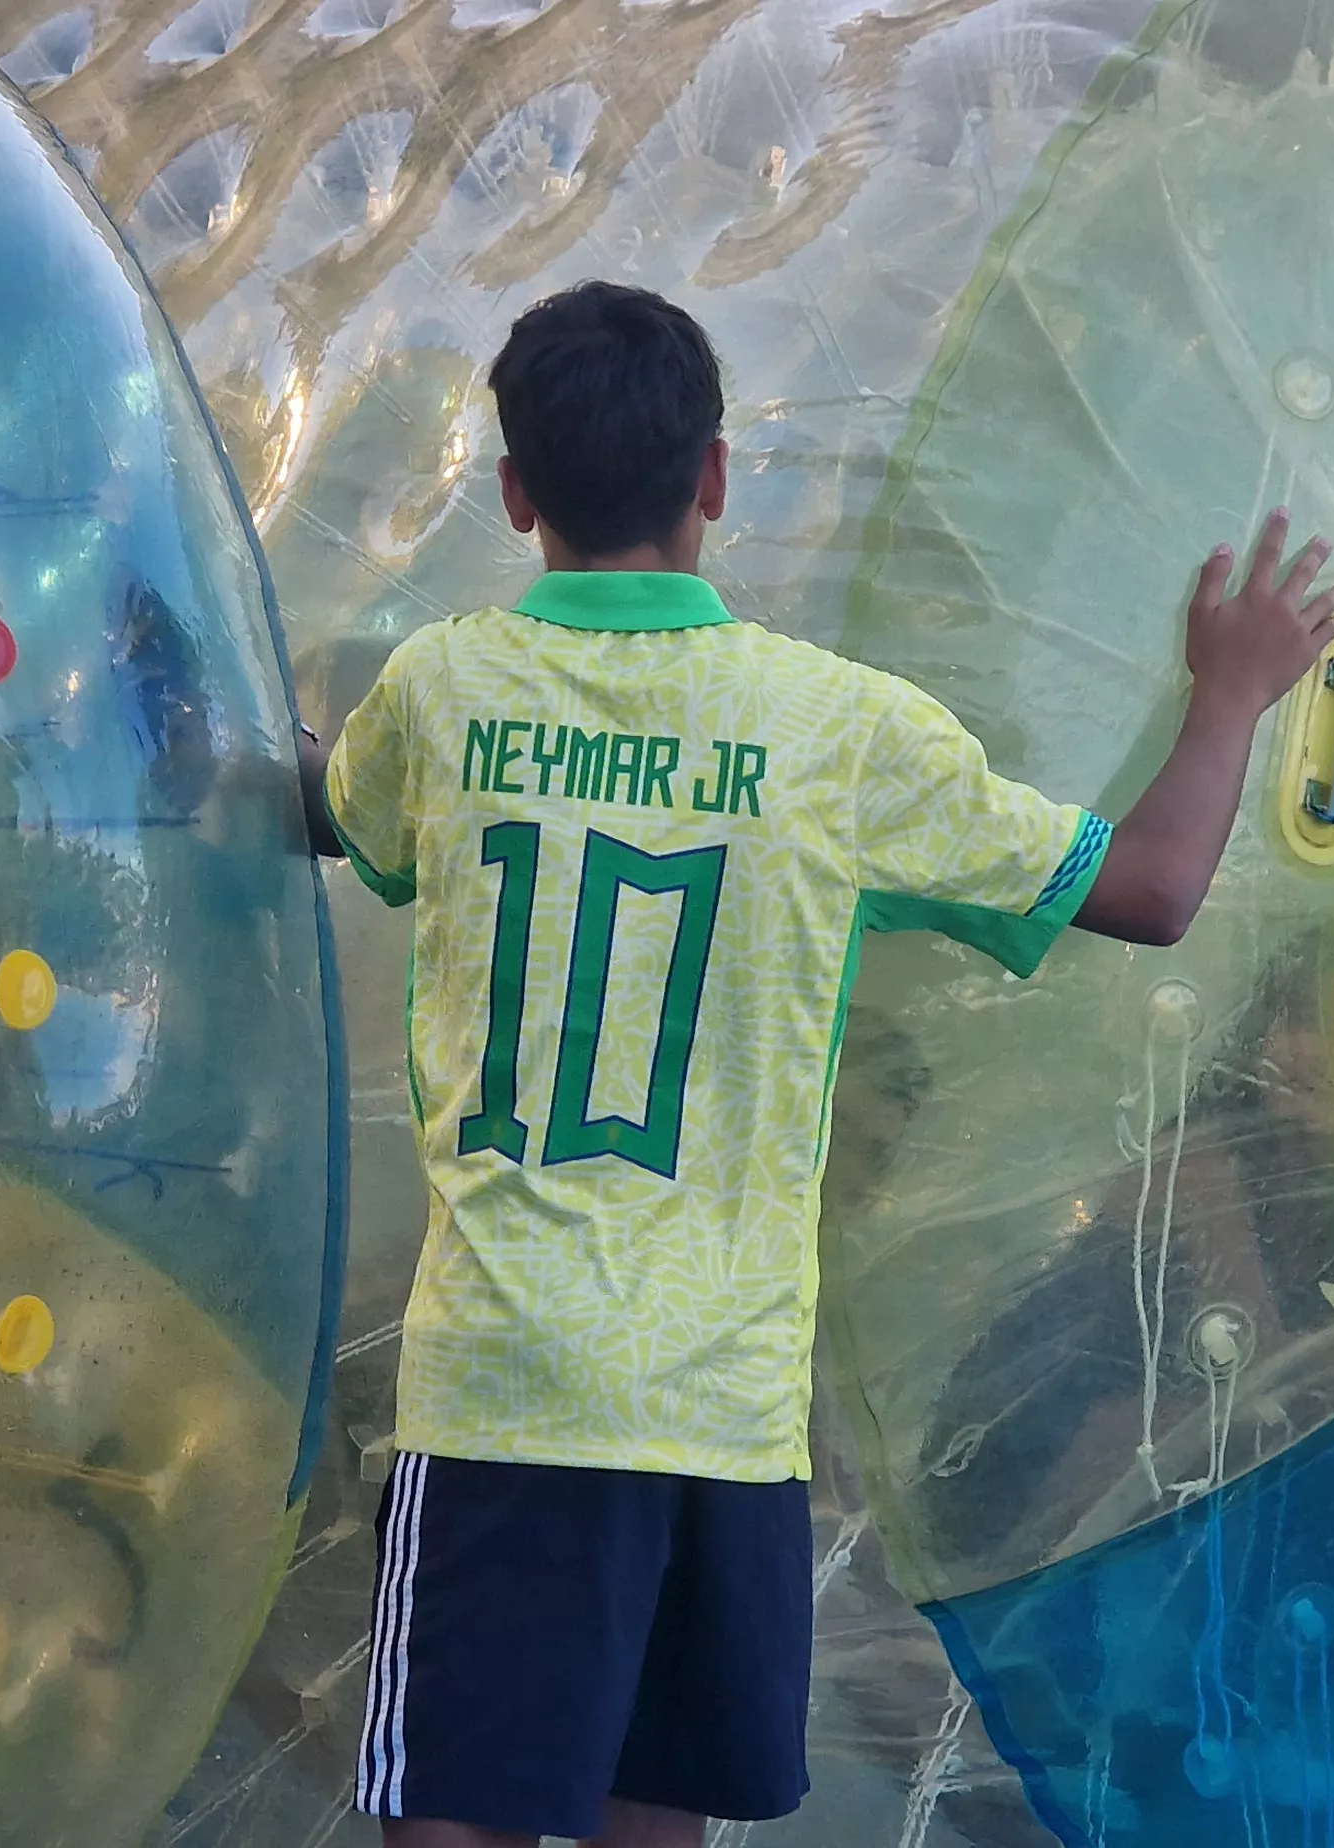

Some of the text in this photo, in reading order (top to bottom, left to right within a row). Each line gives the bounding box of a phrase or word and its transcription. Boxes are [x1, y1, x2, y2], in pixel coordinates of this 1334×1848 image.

[462, 718, 767, 818] NEYMAR JR
[456, 820, 729, 1182] 10
